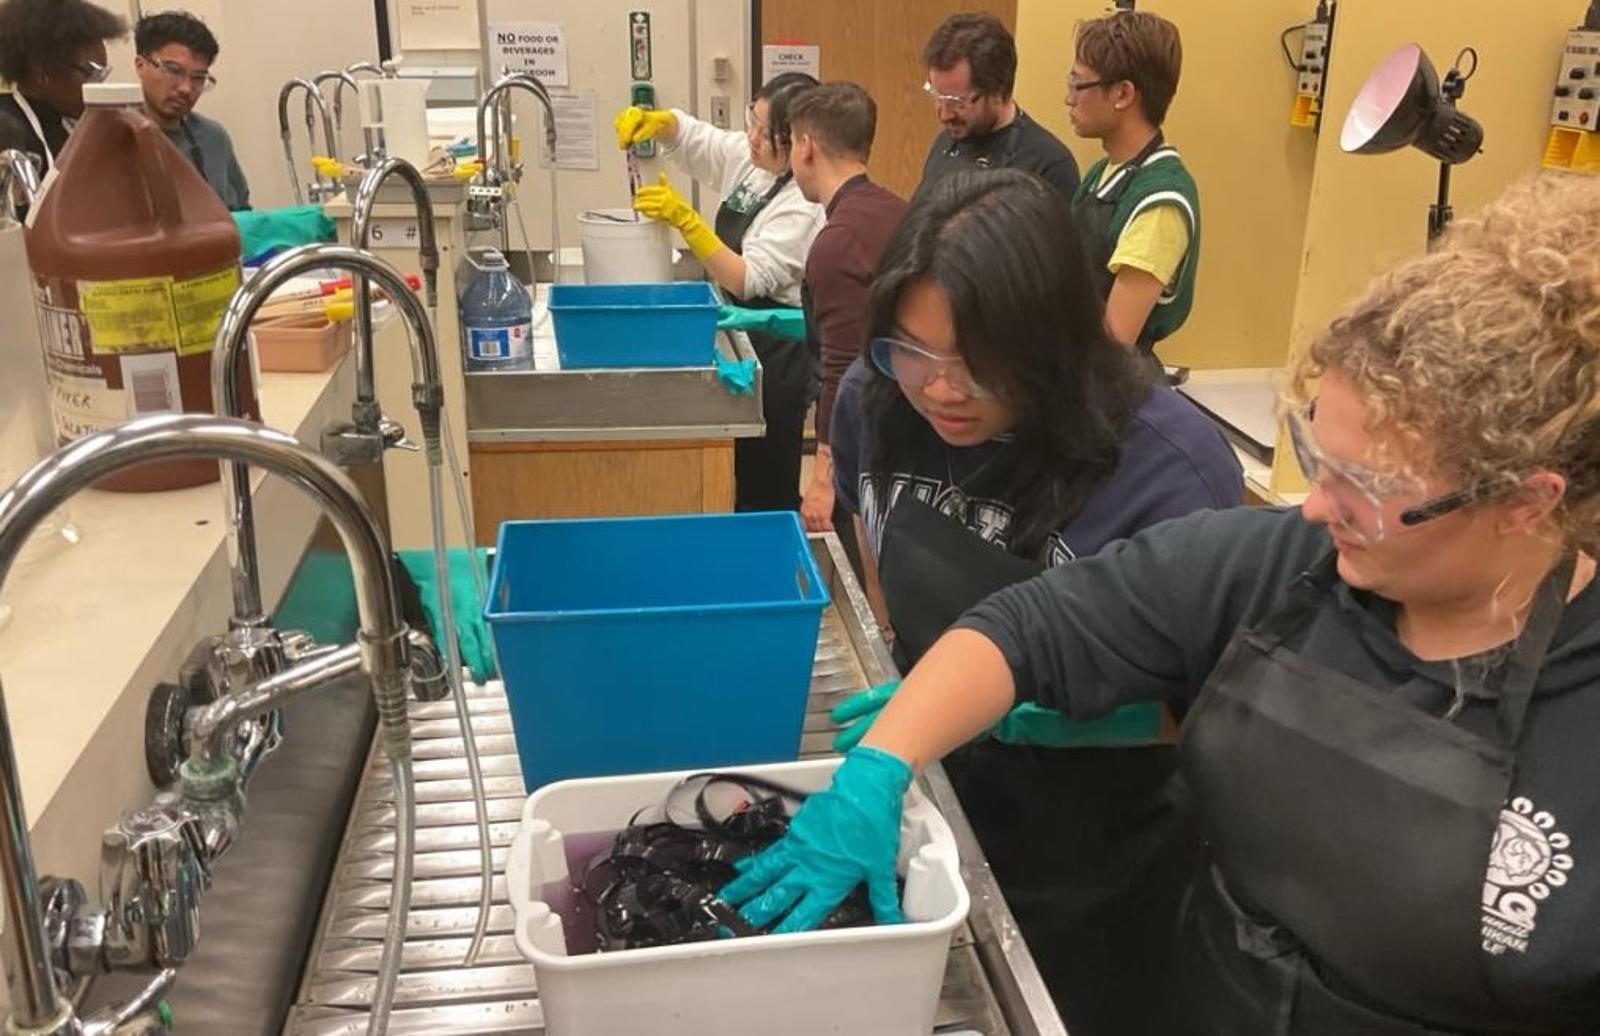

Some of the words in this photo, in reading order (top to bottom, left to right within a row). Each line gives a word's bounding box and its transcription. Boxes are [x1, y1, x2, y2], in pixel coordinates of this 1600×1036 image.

[497, 32, 516, 44] NO
[518, 35, 543, 43] FOOD
[546, 35, 559, 43] OR
[502, 46, 555, 55] BEVERAGES
[524, 58, 536, 66] IN
[372, 224, 383, 240] 6
[405, 224, 417, 240] #
